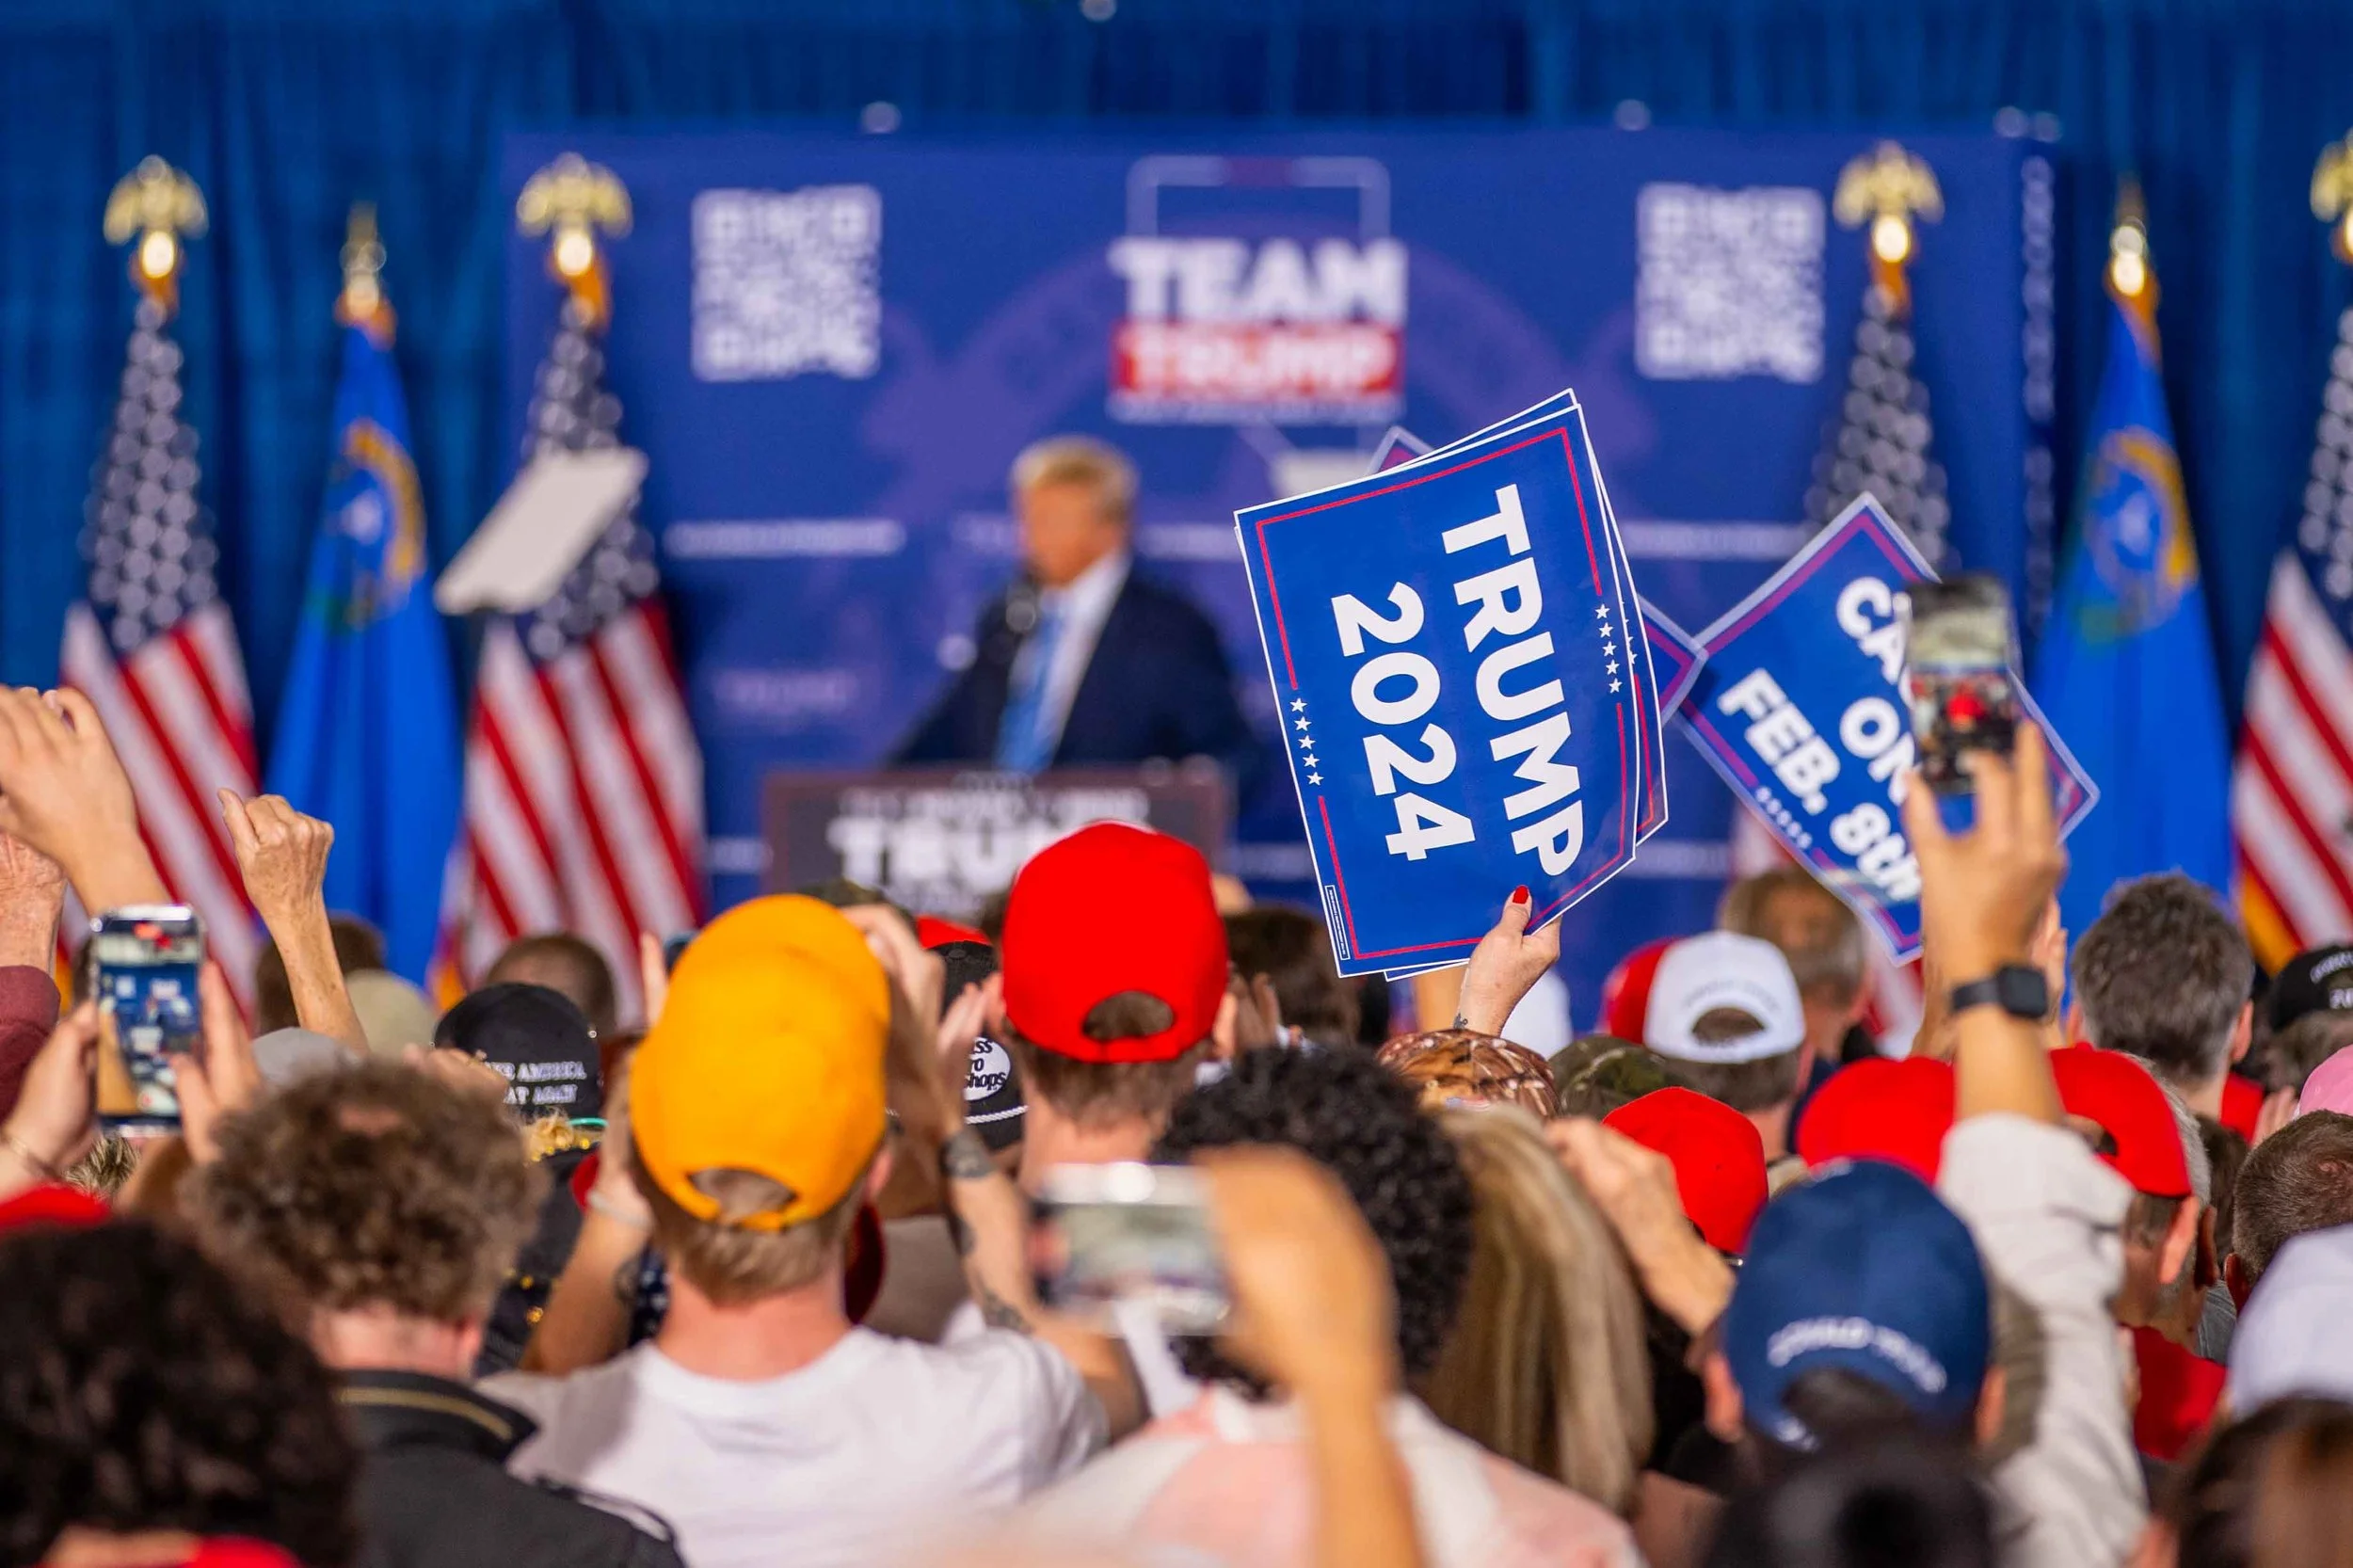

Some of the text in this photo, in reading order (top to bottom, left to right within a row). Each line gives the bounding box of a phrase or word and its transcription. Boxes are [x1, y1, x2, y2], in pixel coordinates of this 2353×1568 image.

[1108, 237, 1408, 322] TEAM
[1114, 321, 1397, 398] TRUMP
[1331, 582, 1476, 861] 2024
[1441, 483, 1584, 876] TRUMP
[1717, 668, 1840, 815] FEB.
